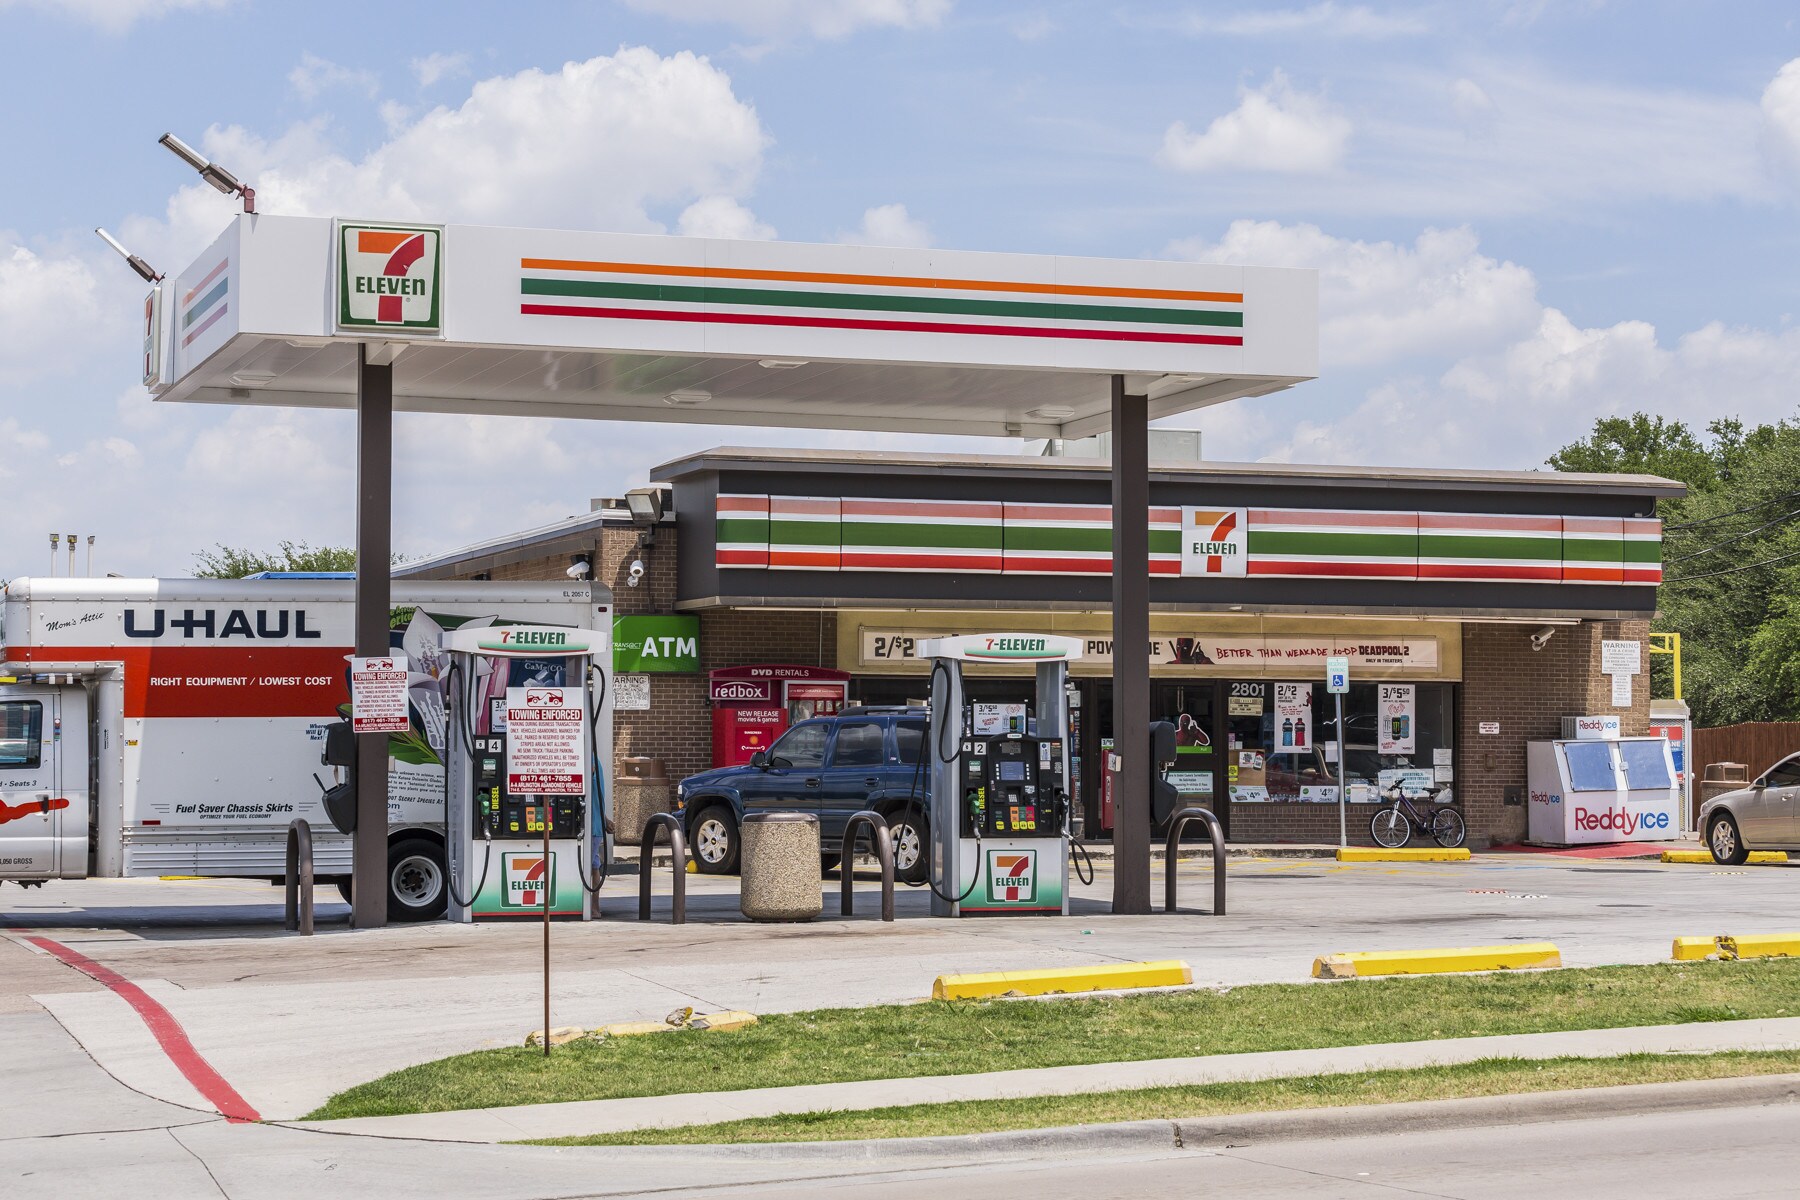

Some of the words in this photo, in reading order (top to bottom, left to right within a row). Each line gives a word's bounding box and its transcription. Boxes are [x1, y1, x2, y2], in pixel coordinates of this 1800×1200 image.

[46, 618, 76, 631] Mom's
[80, 612, 104, 624] Attic
[641, 637, 696, 657] ATM
[1359, 646, 1403, 655] DEADPOOL
[1404, 646, 1409, 655] 2
[1216, 648, 1254, 659] BETTER
[1257, 649, 1282, 658] THAN
[1285, 648, 1328, 657] WEAKADE
[150, 677, 182, 686] RIGHT
[186, 677, 247, 686] EQUIPMENT
[259, 677, 301, 685] LOWEST
[305, 677, 332, 685] COST
[715, 686, 763, 697] redbox
[1232, 683, 1265, 696] 2801
[510, 710, 539, 719] TOWING
[542, 710, 580, 720] ENFORCED
[492, 741, 498, 750] 4
[977, 744, 983, 753] 2
[176, 804, 196, 813] Fuel
[226, 804, 263, 813] Chassis
[265, 803, 293, 812] Skirts
